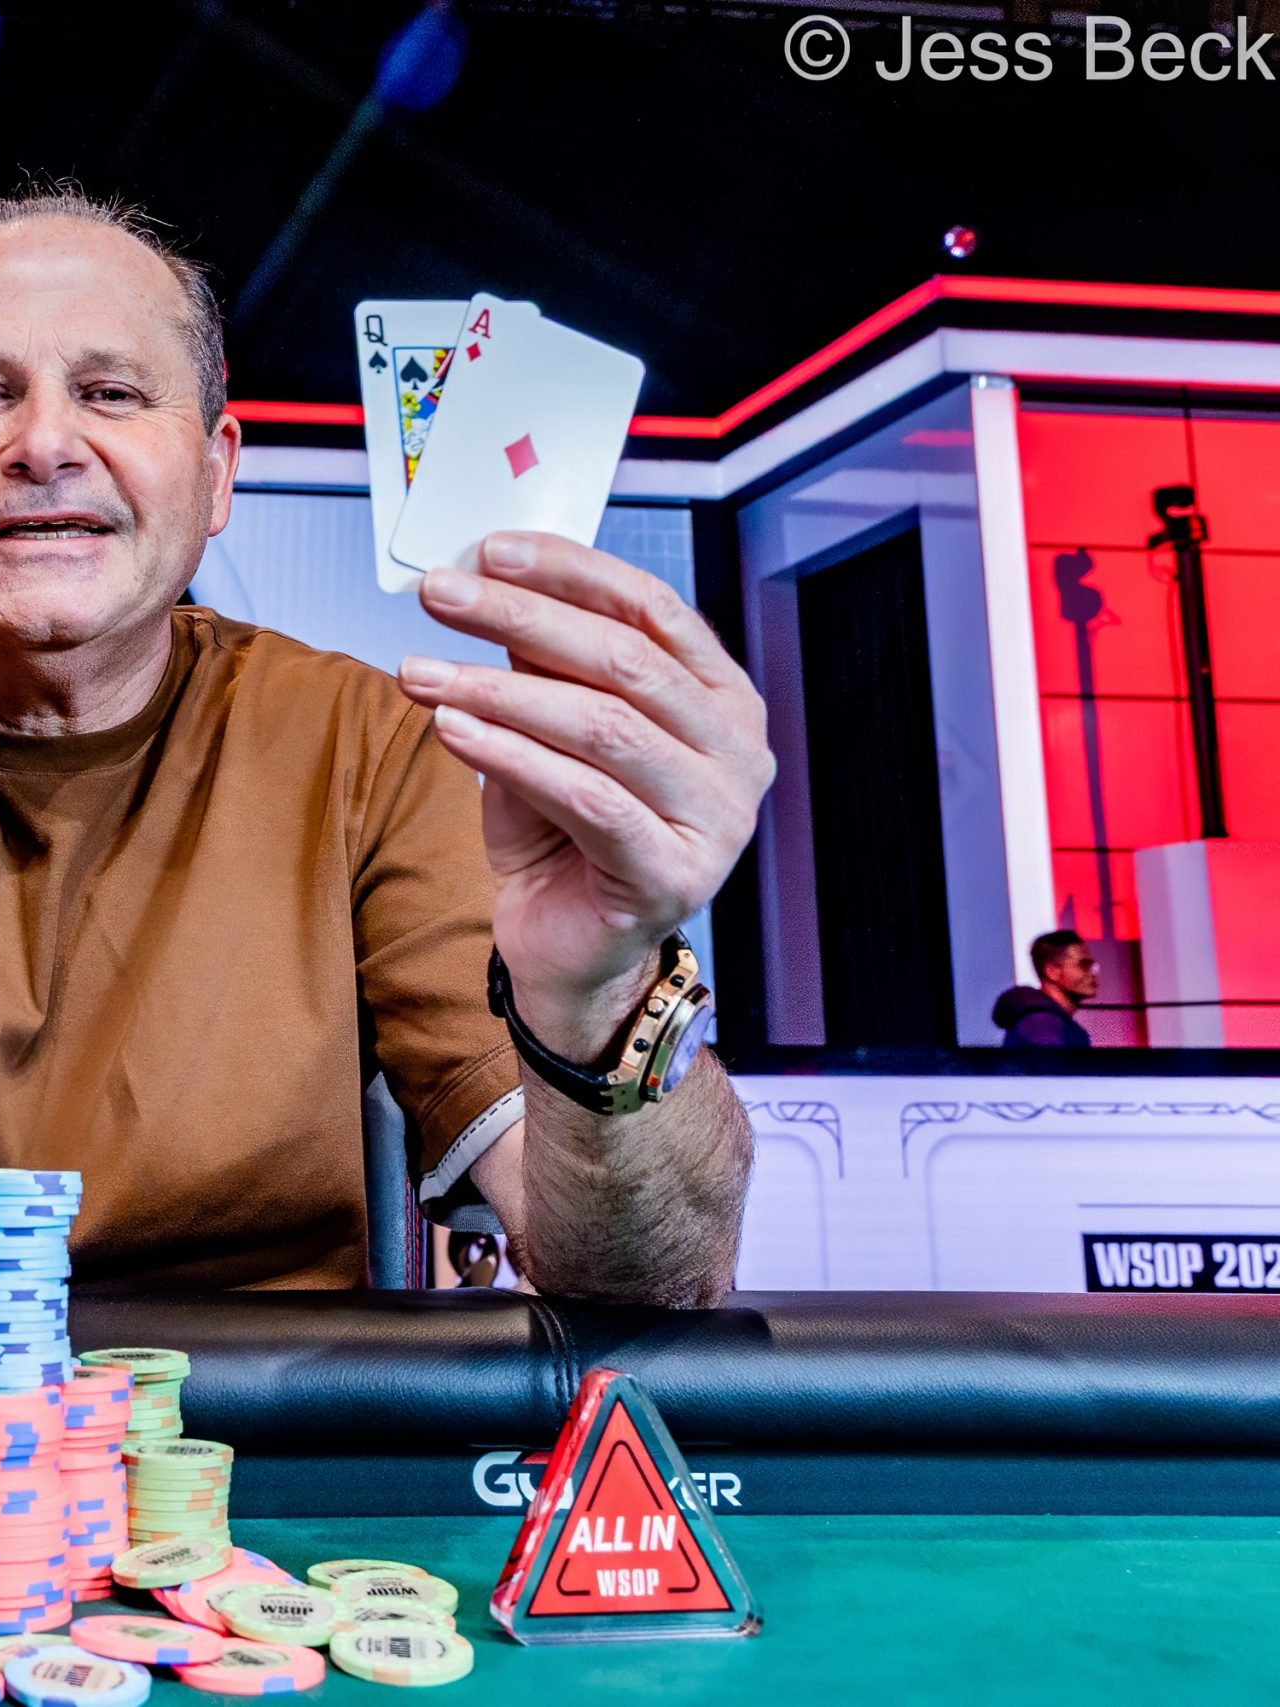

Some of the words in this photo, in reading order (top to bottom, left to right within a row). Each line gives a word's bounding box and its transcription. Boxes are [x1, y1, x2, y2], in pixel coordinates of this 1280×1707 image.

[364, 315, 389, 347] Q
[468, 308, 492, 339] A
[1092, 1242, 1205, 1287] WSOP
[567, 1515, 634, 1553] ALL
[639, 1514, 677, 1551] IN
[596, 1568, 660, 1597] WSOP
[260, 1603, 314, 1615] WSOP
